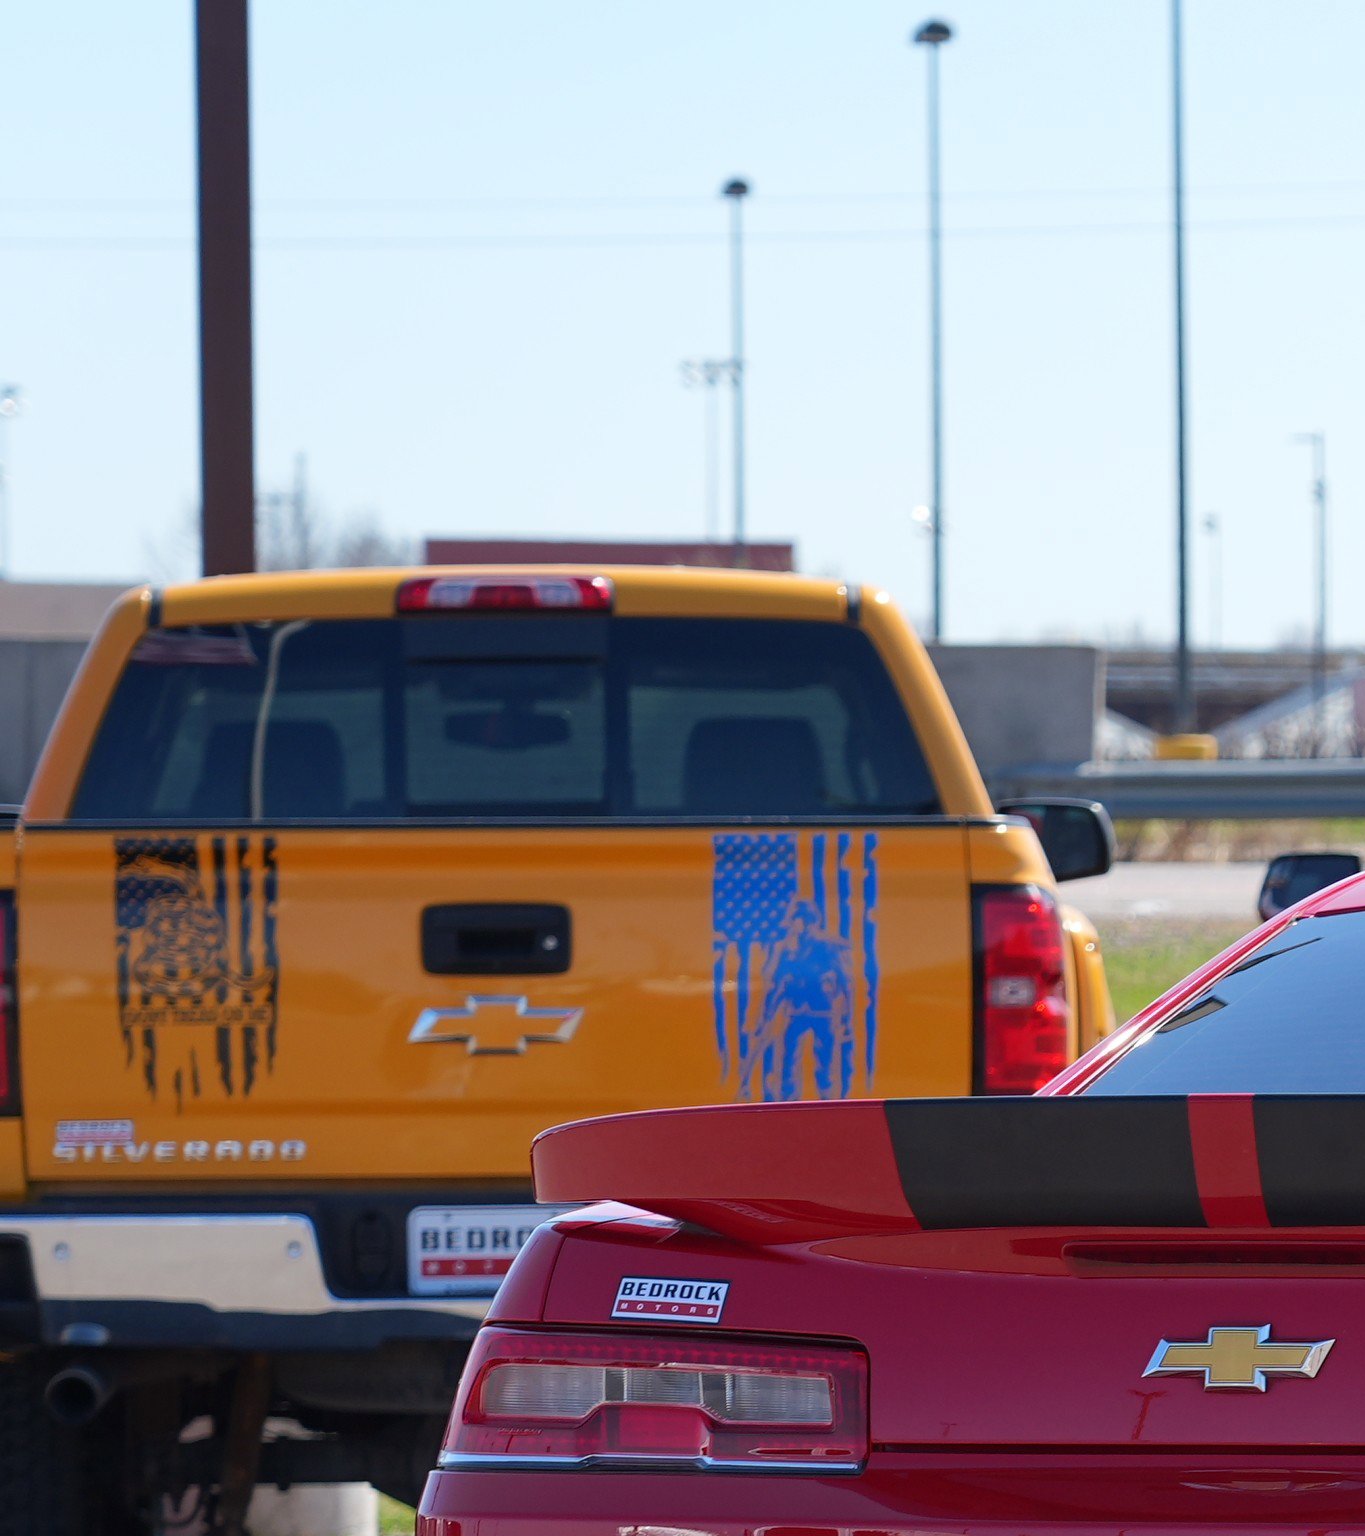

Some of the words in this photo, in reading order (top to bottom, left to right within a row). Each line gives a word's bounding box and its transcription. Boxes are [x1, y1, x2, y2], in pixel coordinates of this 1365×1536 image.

[53, 1140, 307, 1163] SILVERADO
[421, 1228, 532, 1251] BEDRO
[621, 1281, 722, 1301] BEDROCK
[620, 1302, 714, 1315] MOTORS
